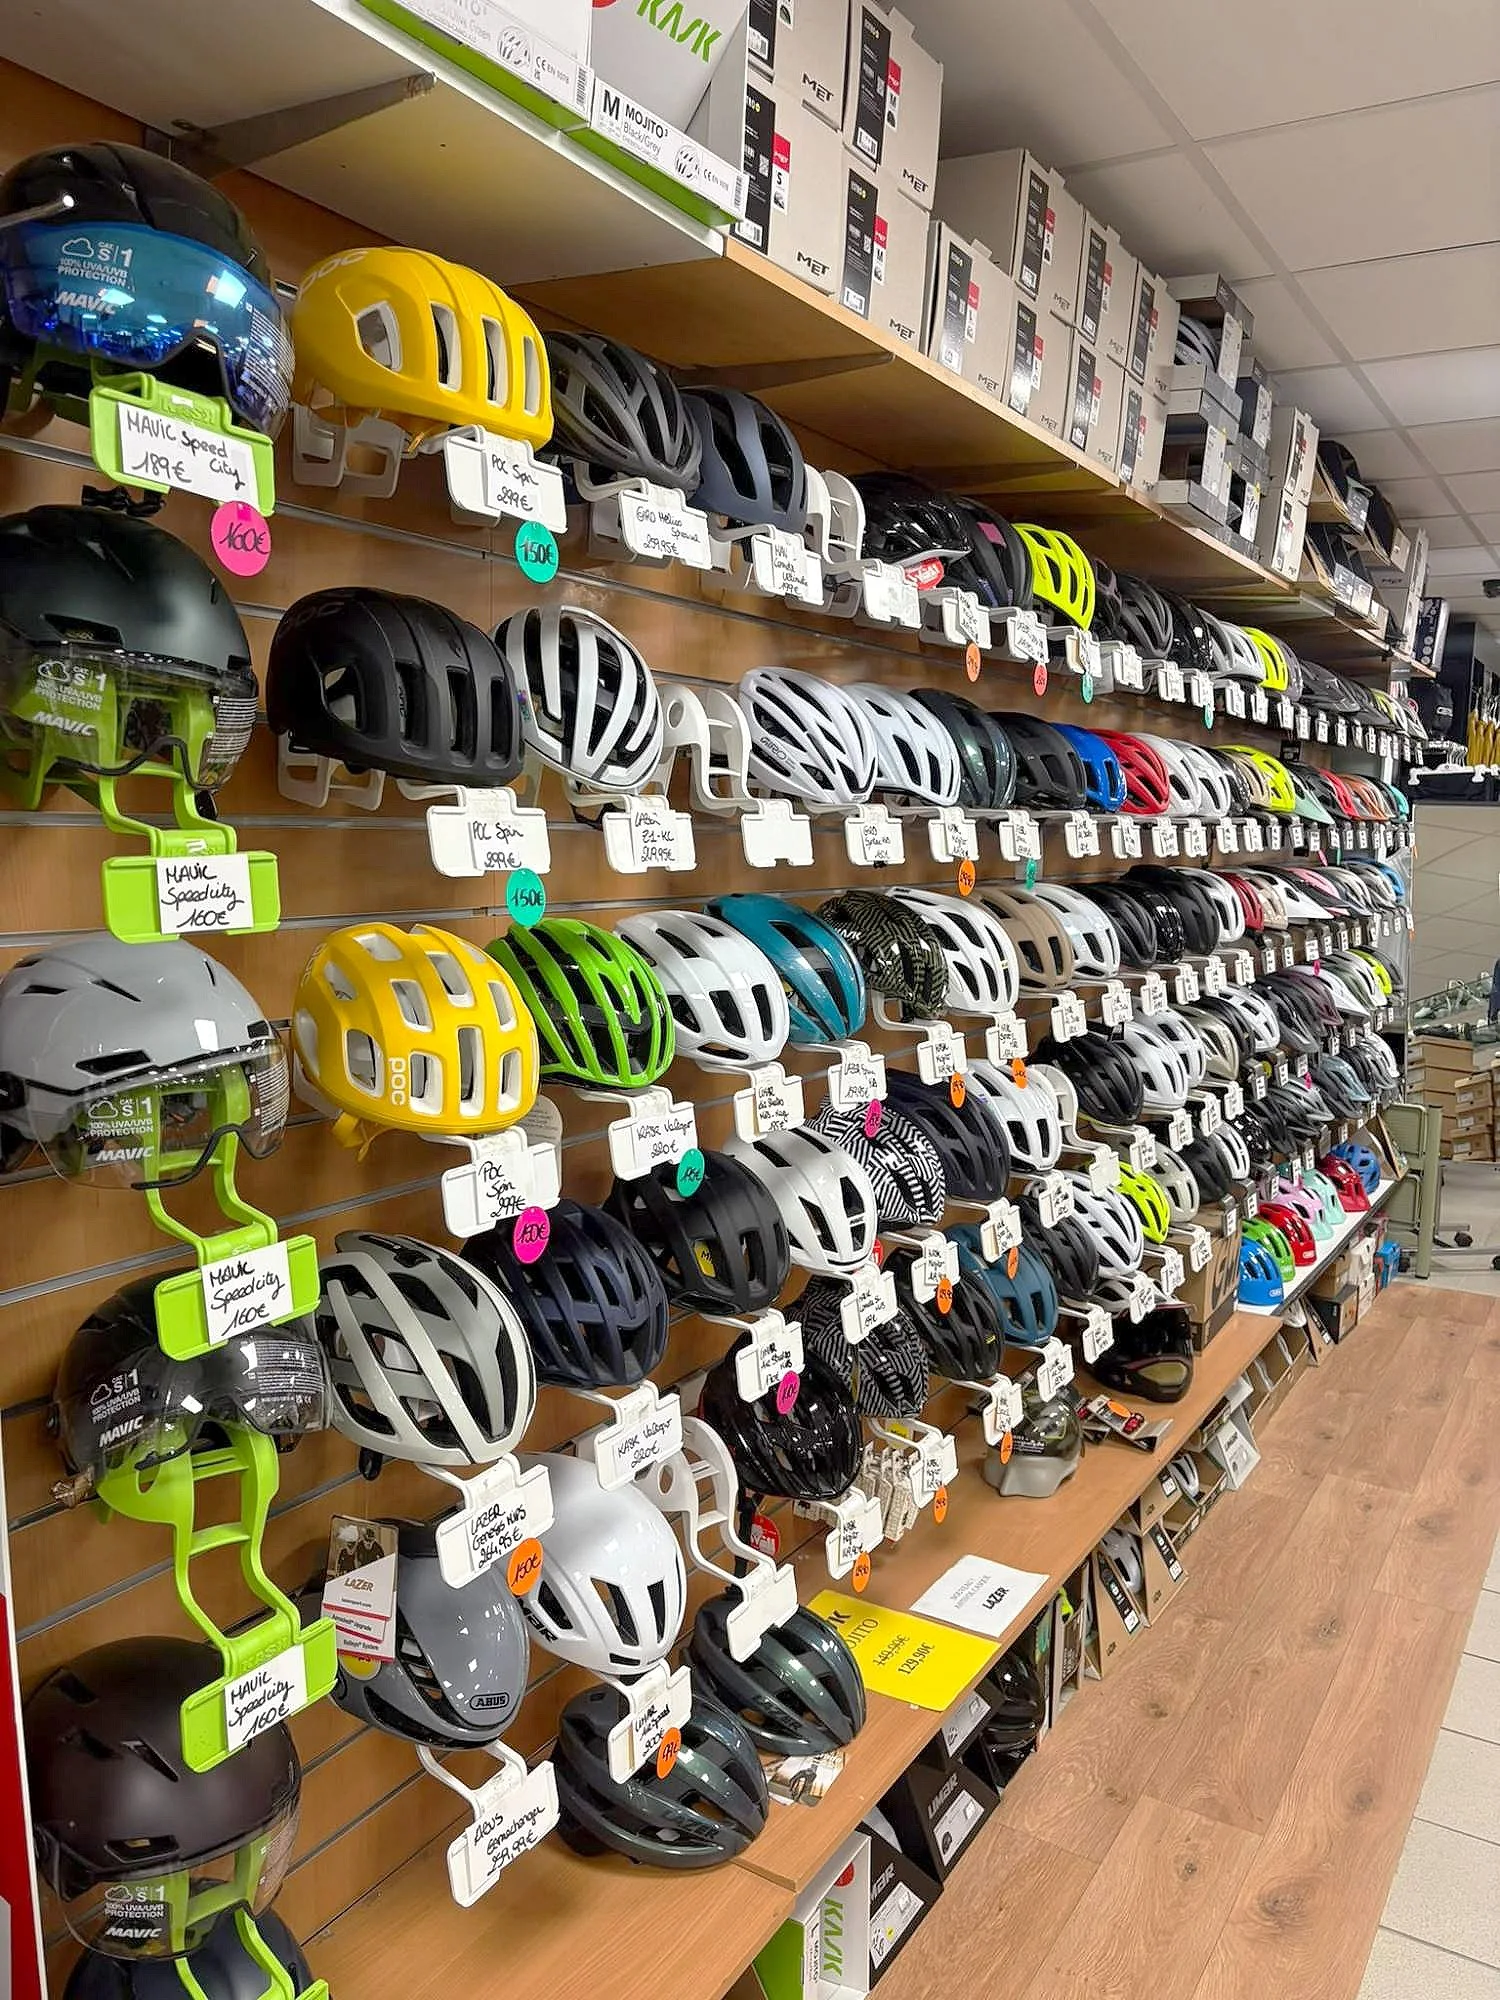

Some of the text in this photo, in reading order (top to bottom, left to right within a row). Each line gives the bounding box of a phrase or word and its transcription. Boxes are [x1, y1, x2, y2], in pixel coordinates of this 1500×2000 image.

[802, 72, 834, 103] MET
[603, 89, 621, 121] M
[902, 168, 929, 193] MET
[57, 264, 127, 288] PROTECTION
[797, 251, 830, 277] MET
[55, 291, 116, 316] MAVIC
[889, 318, 915, 341] MET
[977, 373, 999, 392] MET
[126, 409, 228, 457] MAVIC Speed
[131, 451, 246, 491] 189€ City
[219, 522, 269, 555] 160€
[519, 540, 558, 567] 150€
[34, 711, 97, 737] MAVIC
[759, 735, 787, 761] GIRO
[165, 861, 217, 885] MAVIC
[510, 887, 546, 908] 150€
[176, 909, 231, 929] 160€
[89, 1126, 154, 1138] PROTECTION
[95, 1147, 155, 1163] MAVIC
[209, 1261, 255, 1289] MAVIC
[220, 1304, 271, 1337] 160€
[91, 1398, 142, 1424] PROTECTION
[99, 1415, 144, 1448] MAVIC
[471, 1502, 506, 1535] LAZER
[344, 1576, 374, 1593] LAZER
[511, 1555, 543, 1588] 150€
[981, 1586, 1010, 1611] LAZER
[897, 1644, 935, 1676] 129,90€
[230, 1670, 272, 1701] MAVIC
[475, 1694, 506, 1708] ABUS
[242, 1704, 290, 1742] 160€
[927, 1772, 959, 1820] LIMAR
[104, 1908, 165, 1919] PROTECTION
[105, 1925, 163, 1939] MAVIC
[822, 1898, 844, 1977] KASK
